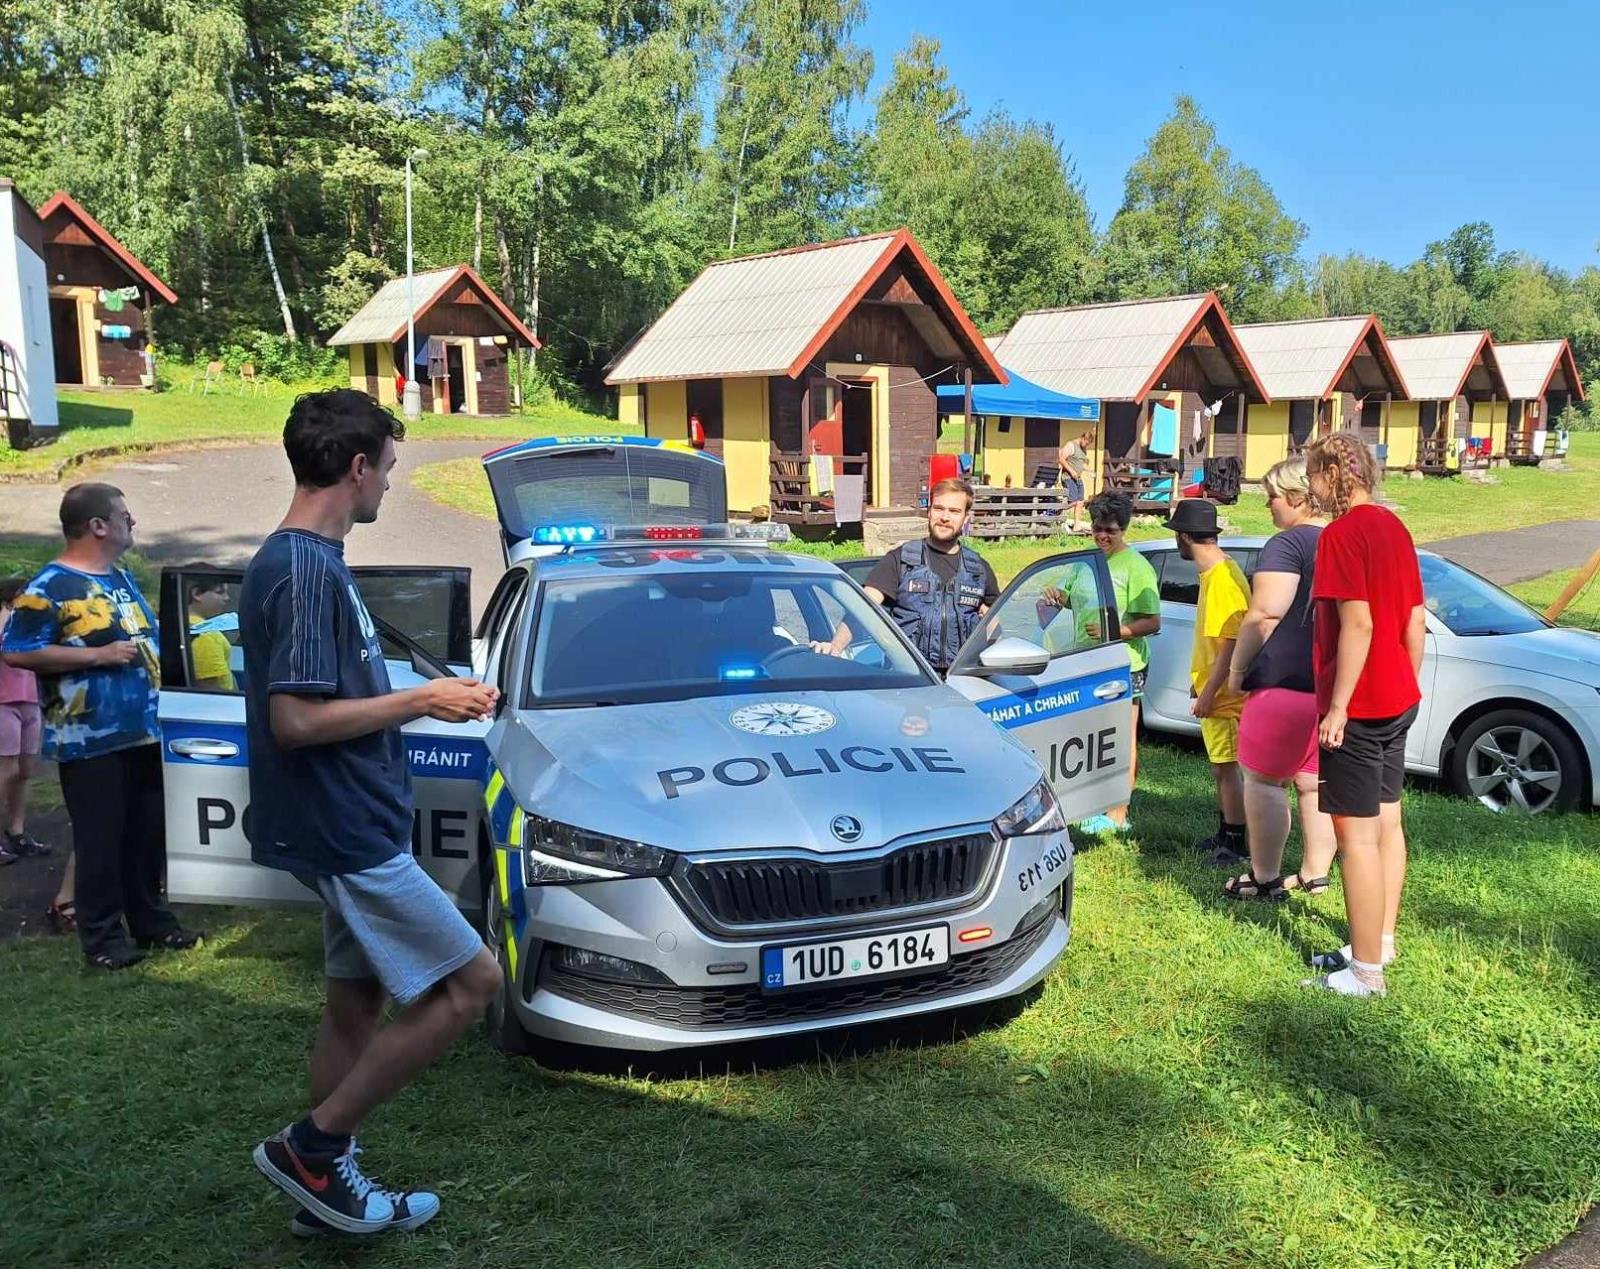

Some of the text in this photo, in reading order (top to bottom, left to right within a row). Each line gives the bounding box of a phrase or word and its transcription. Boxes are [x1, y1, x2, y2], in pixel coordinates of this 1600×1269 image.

[986, 690, 1081, 723] ÁHAT A CHRÁNIT
[656, 745, 967, 800] POLICIE
[1048, 726, 1117, 784] ICIE
[767, 973, 783, 985] CZ
[792, 932, 935, 981] 1UD 6184
